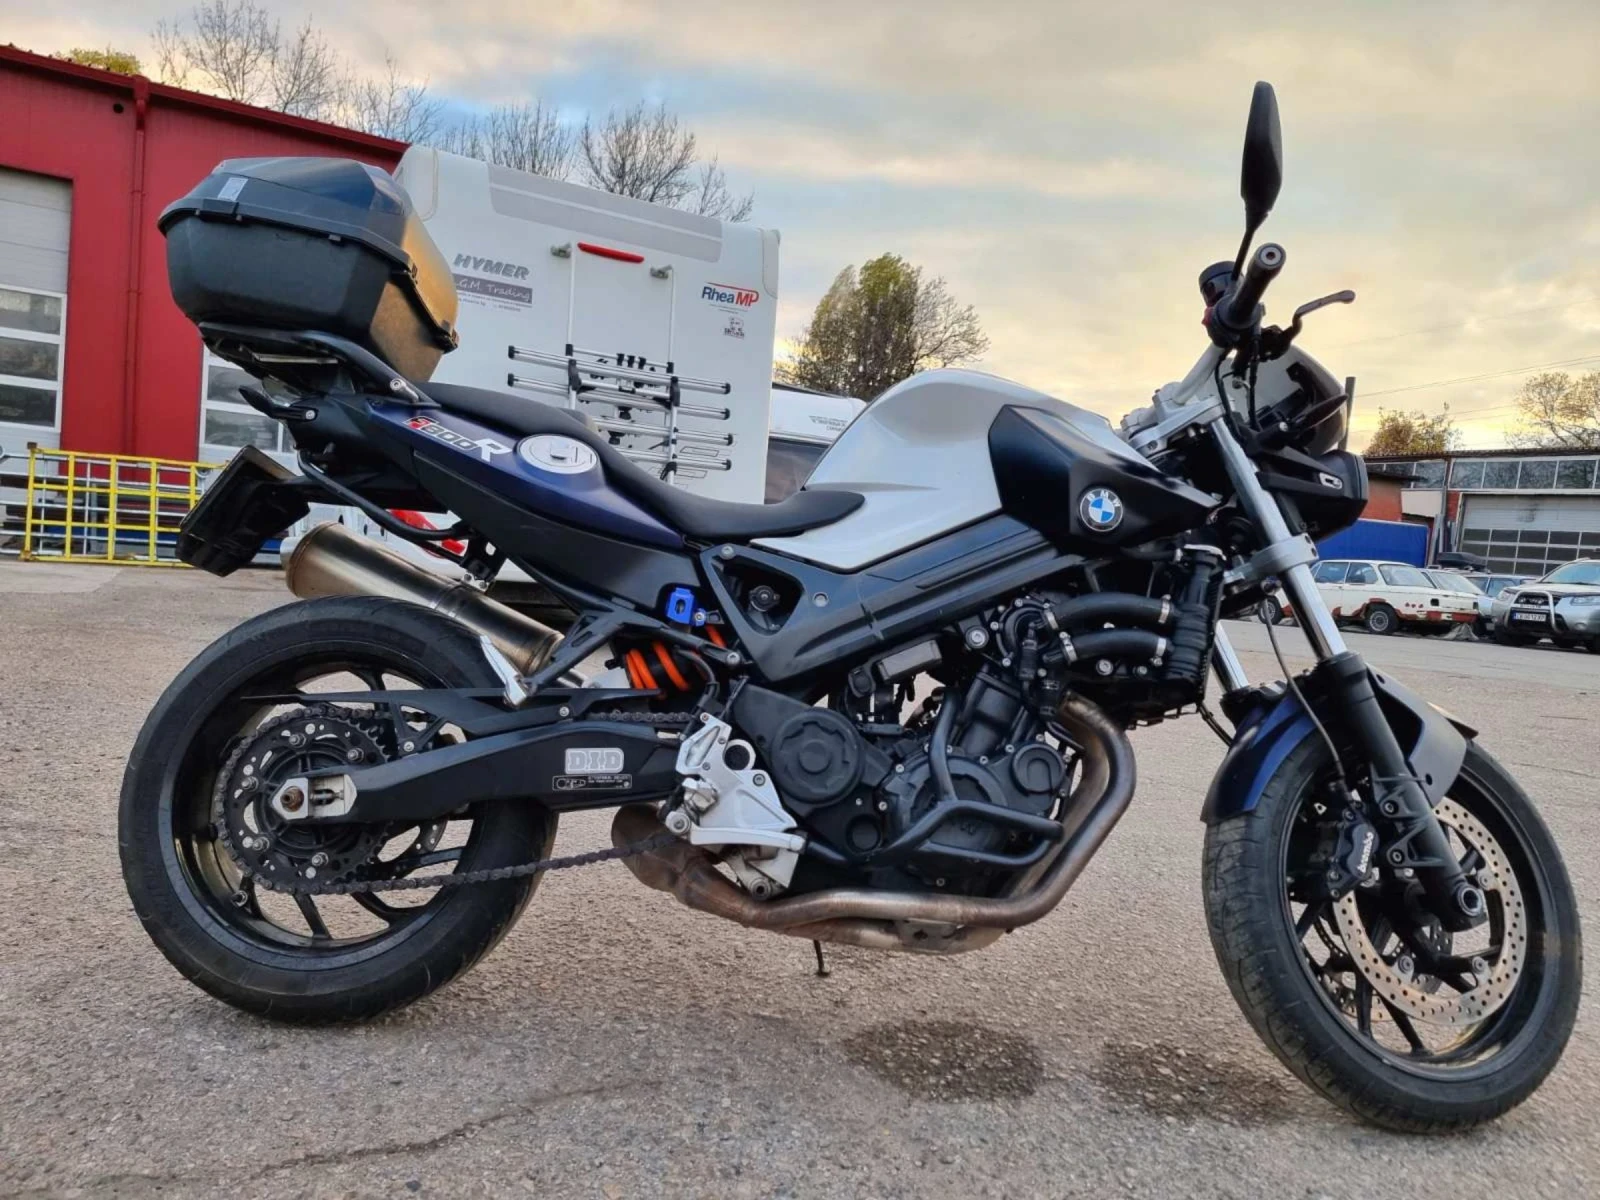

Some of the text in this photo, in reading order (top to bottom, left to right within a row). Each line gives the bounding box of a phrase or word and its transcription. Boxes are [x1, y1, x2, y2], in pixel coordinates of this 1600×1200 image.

[453, 253, 530, 280] HYMER
[487, 283, 530, 303] Trading
[1086, 489, 1121, 507] BMW
[1357, 831, 1375, 873] brembo
